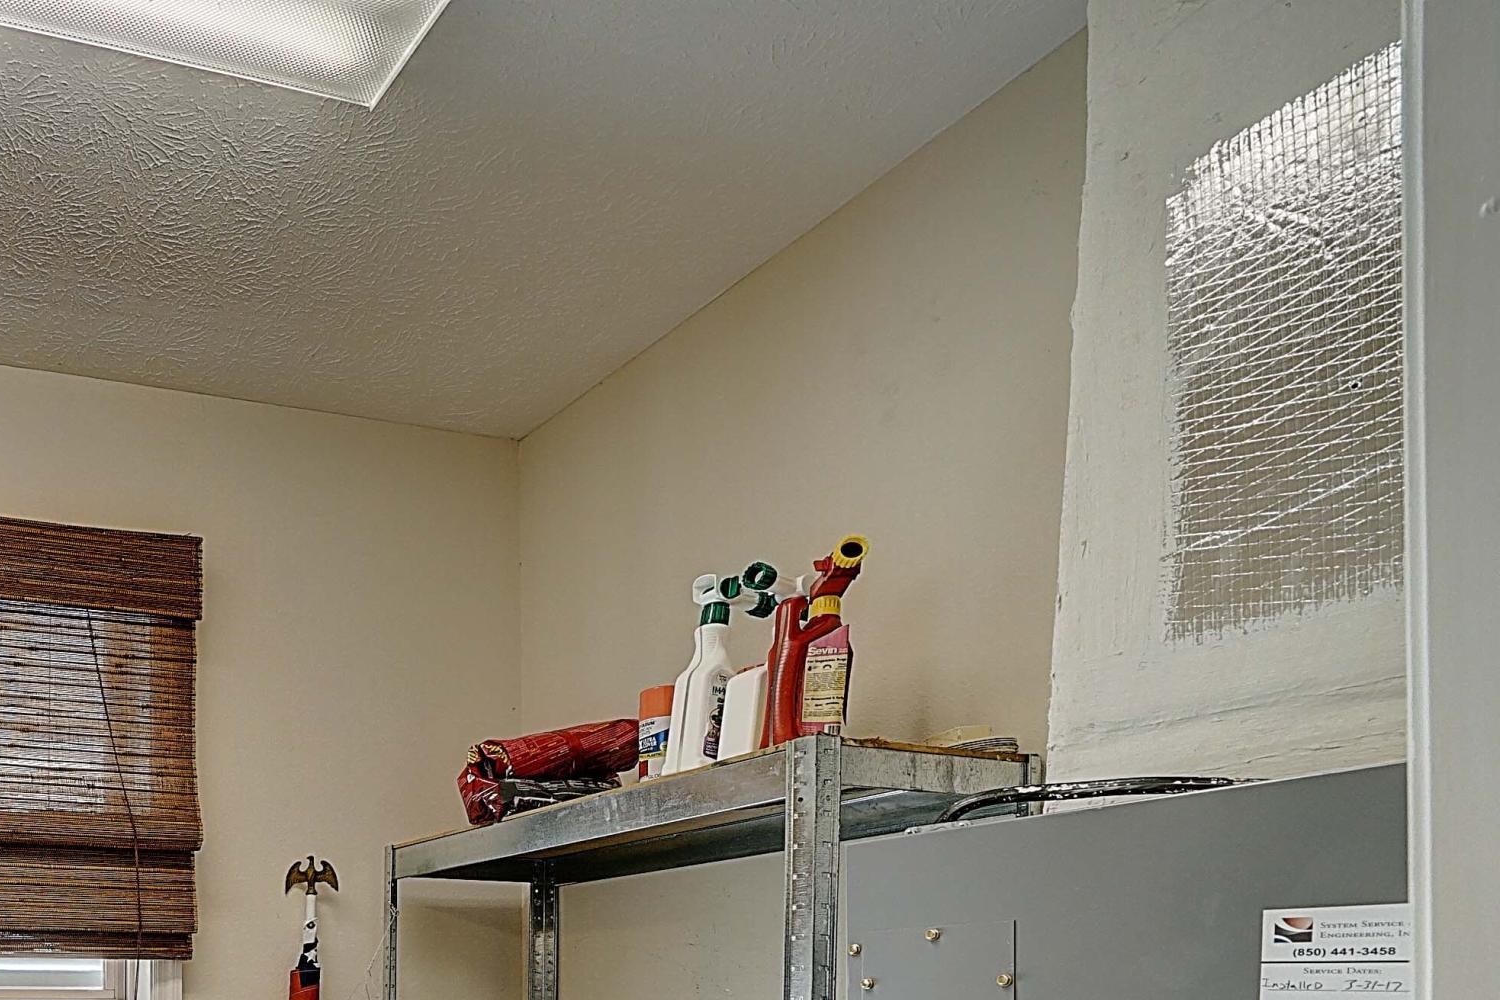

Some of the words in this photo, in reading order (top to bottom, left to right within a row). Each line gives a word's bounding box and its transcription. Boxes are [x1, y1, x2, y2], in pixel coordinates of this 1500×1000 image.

[808, 647, 838, 656] Sevin
[1361, 919, 1404, 928] SERVICE
[1398, 929, 1410, 937] IN
[1293, 947, 1326, 958] (850)
[1330, 946, 1396, 956] 441-3458
[1303, 967, 1342, 975] SERVICE
